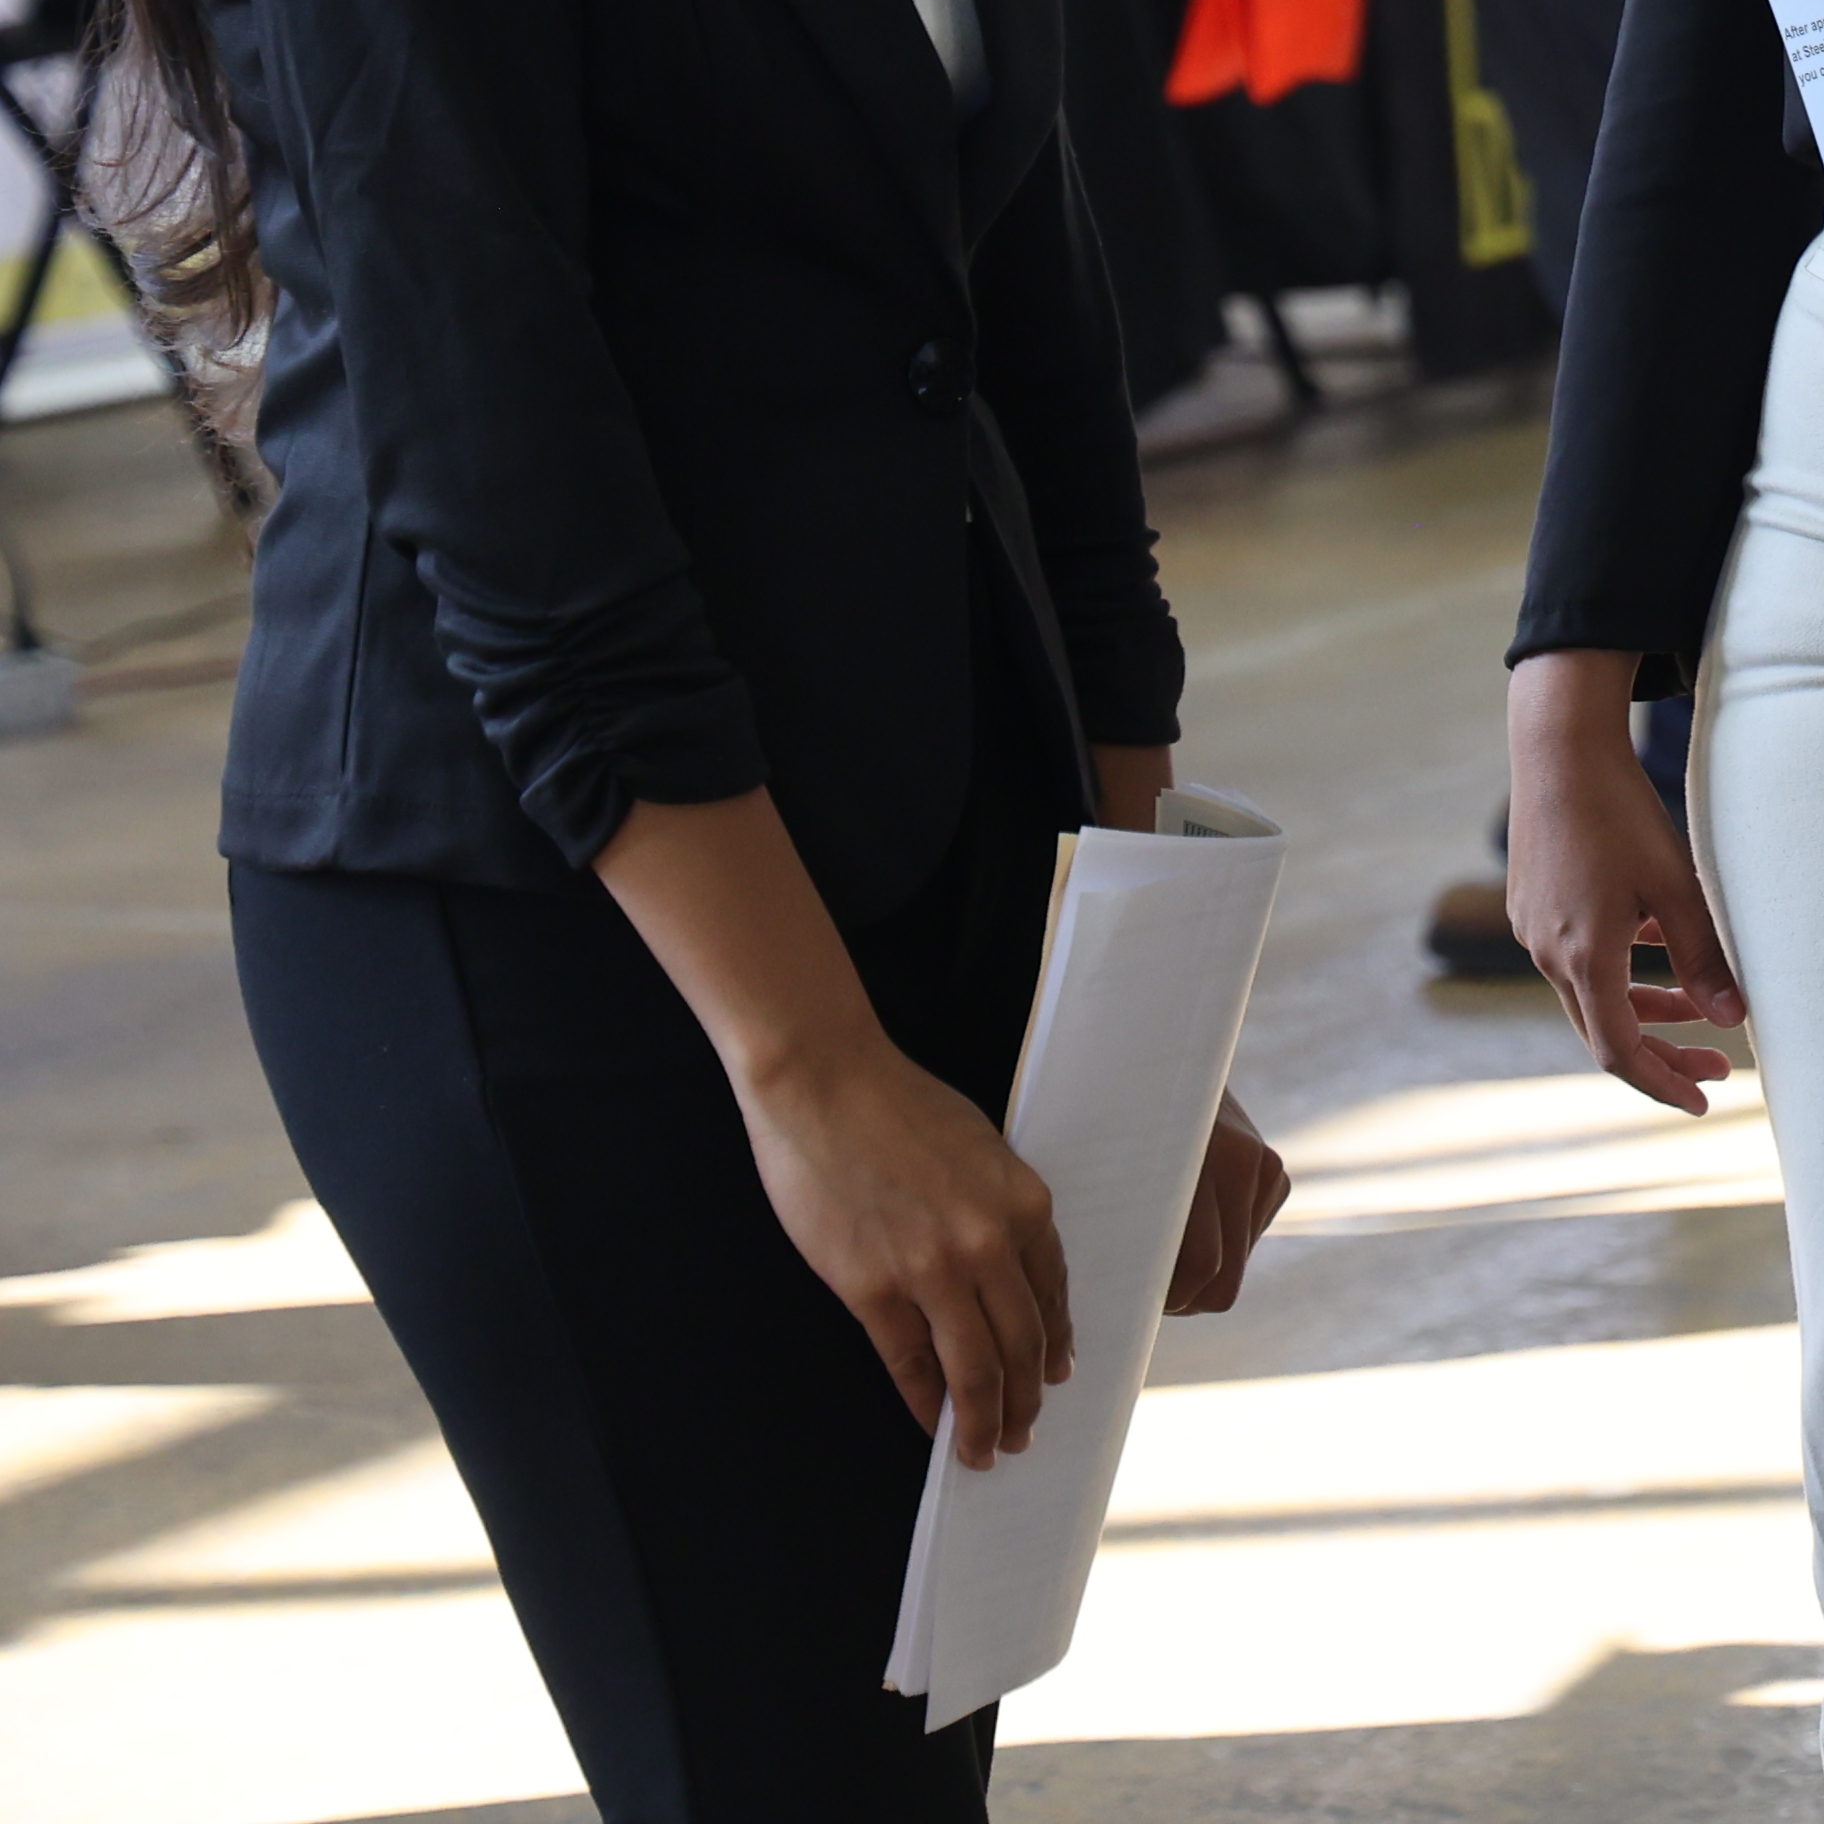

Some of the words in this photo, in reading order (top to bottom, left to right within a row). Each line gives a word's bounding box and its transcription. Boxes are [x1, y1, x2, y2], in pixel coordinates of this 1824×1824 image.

[1784, 24, 1809, 40] After
[1791, 49, 1803, 62] at
[1798, 70, 1818, 87] you
